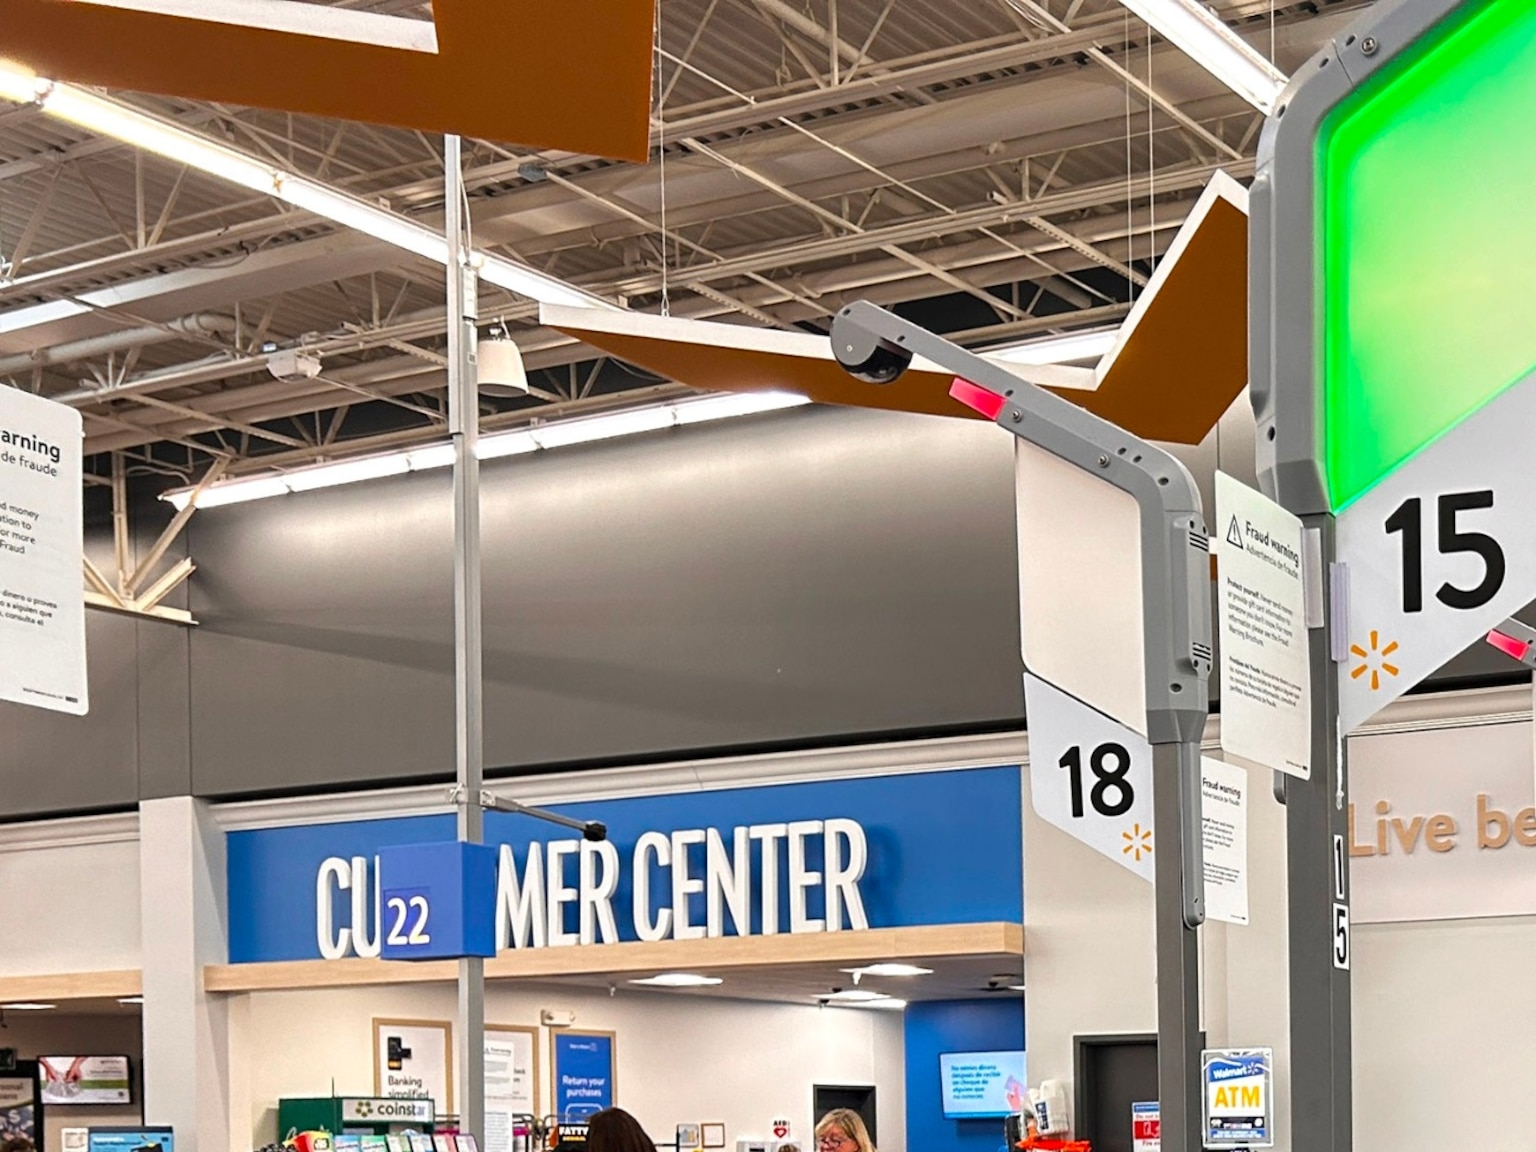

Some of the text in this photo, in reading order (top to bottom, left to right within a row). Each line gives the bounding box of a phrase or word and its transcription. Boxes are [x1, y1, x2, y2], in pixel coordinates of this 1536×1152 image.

[0, 429, 60, 463] arning
[1, 451, 57, 477] de fraude
[1246, 520, 1299, 569] Fraud warning
[1384, 489, 1507, 614] 15
[1057, 741, 1136, 819] 18
[1348, 800, 1457, 859] Live
[316, 817, 869, 960] CUMER CENTER
[386, 895, 431, 946] 22
[388, 1075, 423, 1088] Banking
[562, 1075, 605, 1088] Return your
[1213, 1063, 1247, 1080] Walmart
[566, 1086, 602, 1099] purchases
[1213, 1085, 1261, 1109] ATM
[377, 1102, 426, 1117] coinstar
[559, 1126, 590, 1137] FATTY
